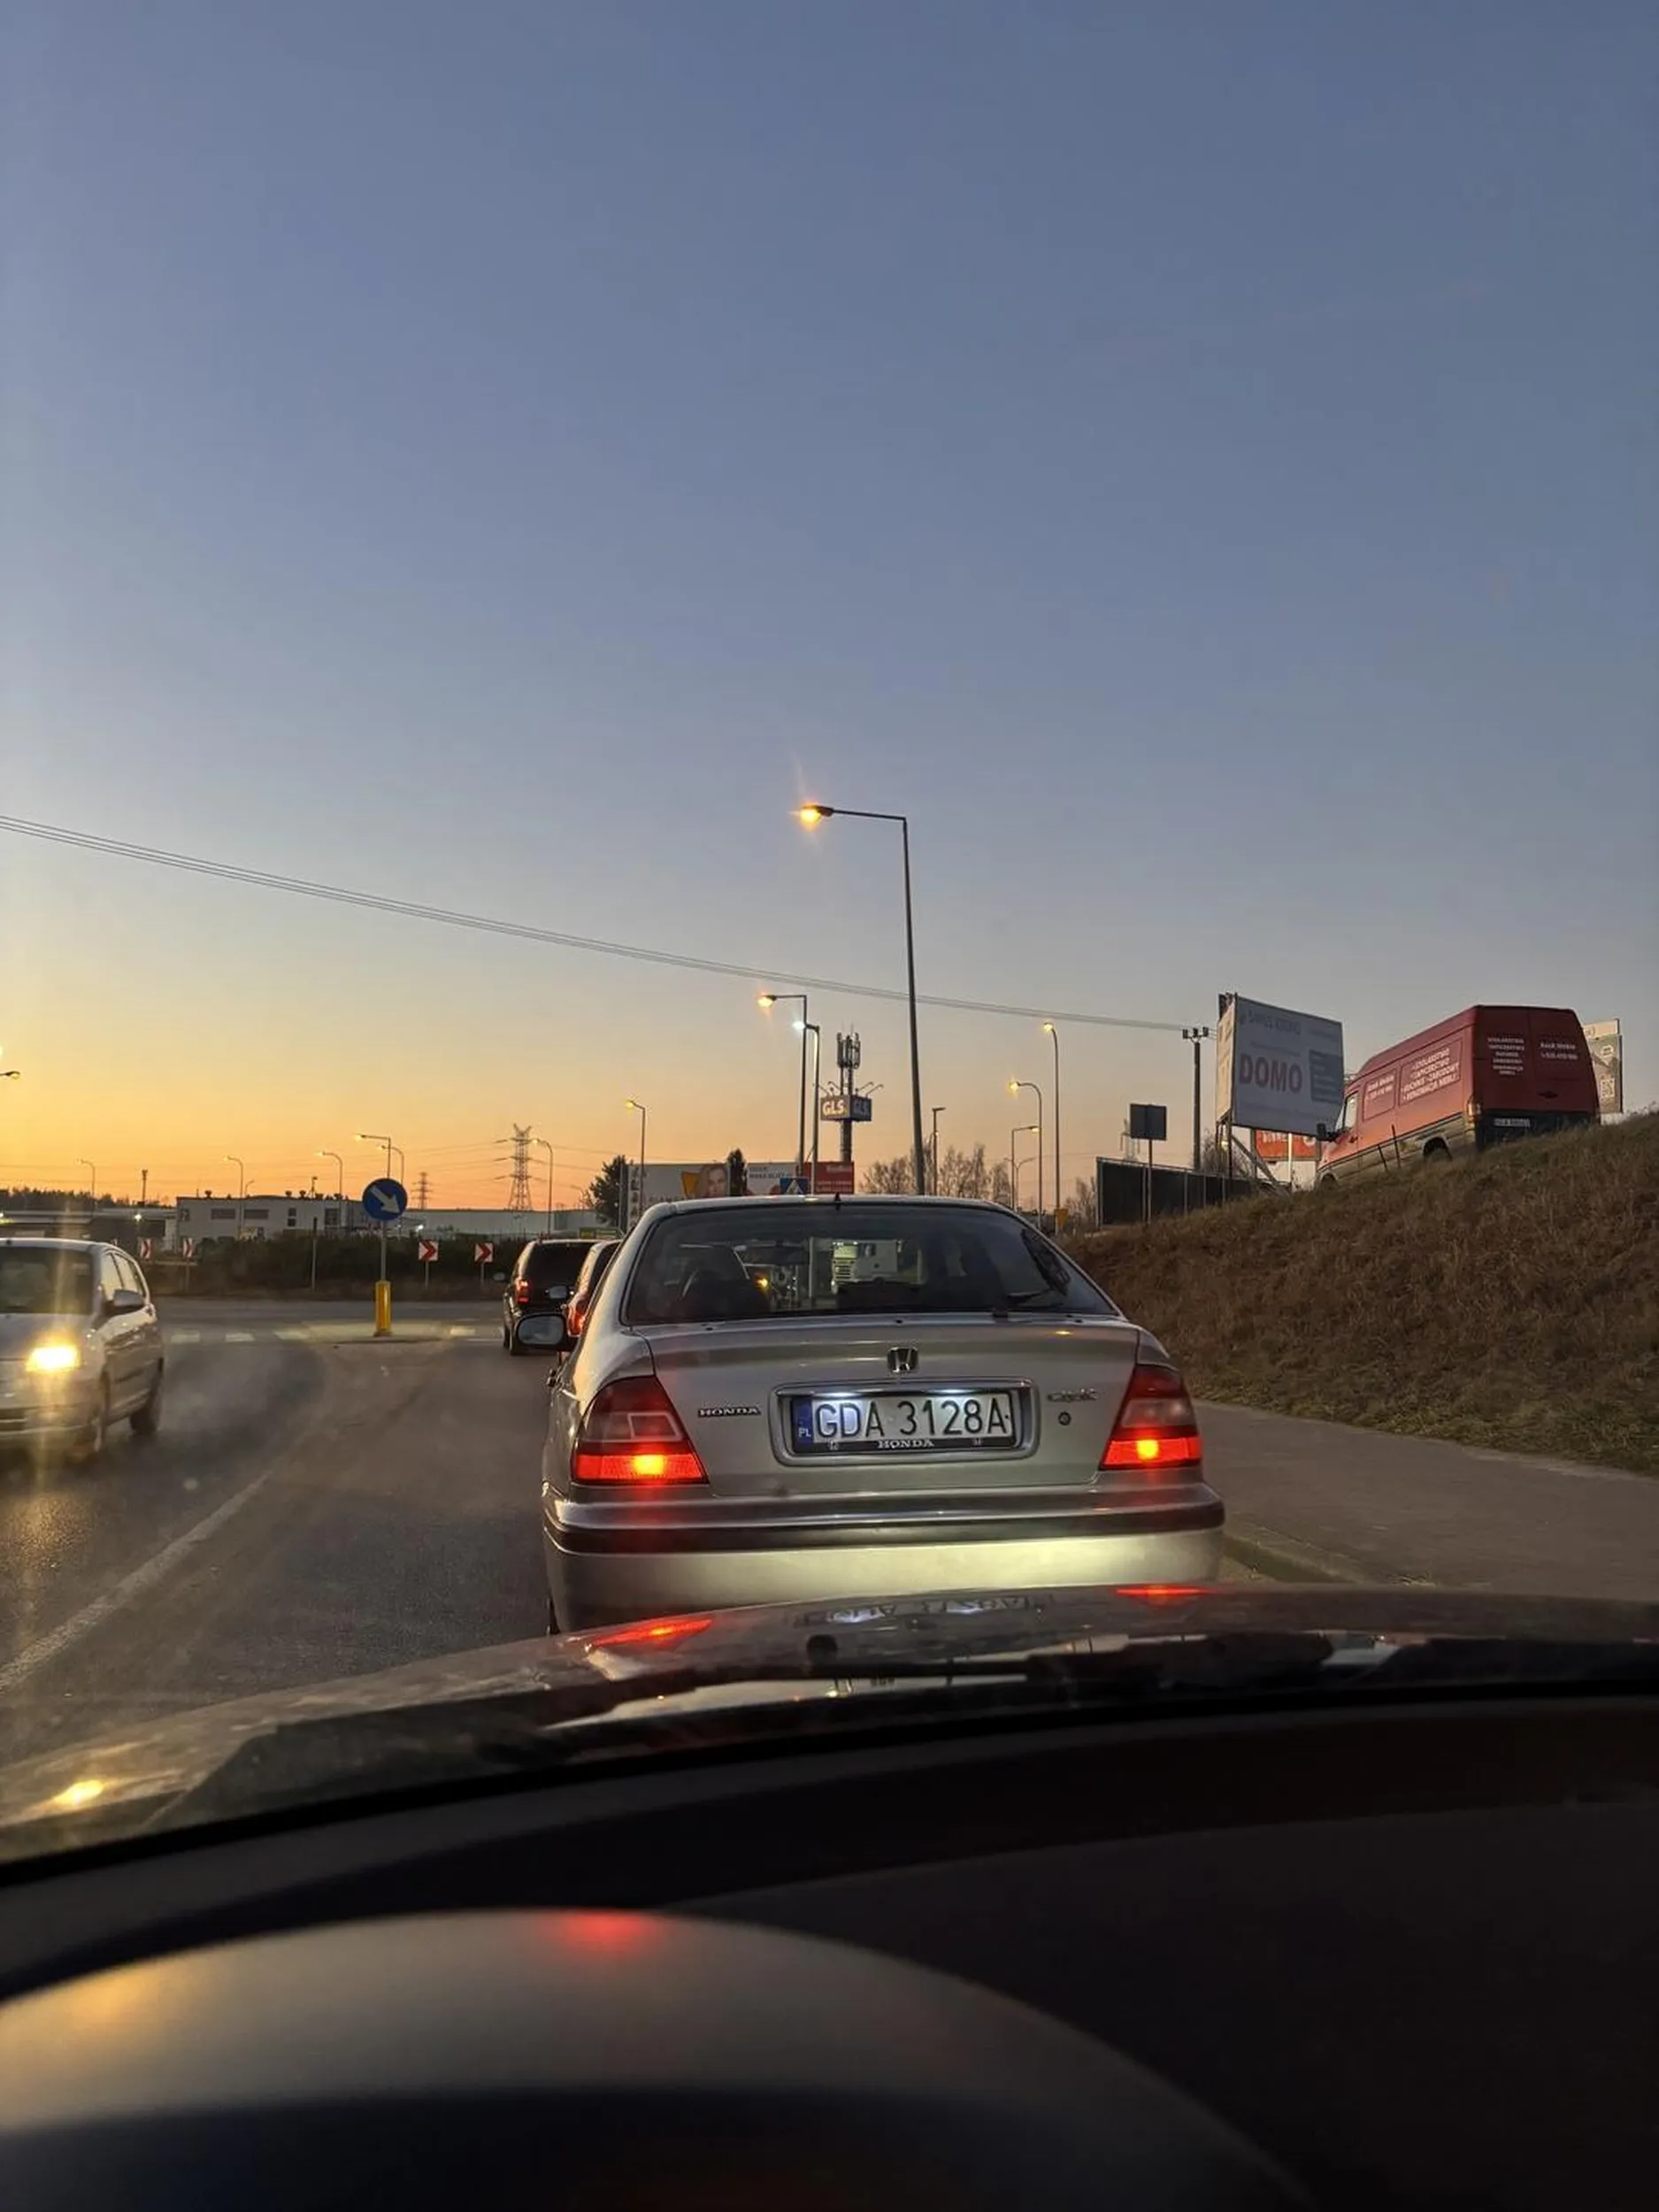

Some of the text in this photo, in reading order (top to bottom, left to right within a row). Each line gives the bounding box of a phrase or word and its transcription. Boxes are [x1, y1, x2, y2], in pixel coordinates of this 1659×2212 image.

[1239, 1052, 1303, 1094] DOMO
[822, 1098, 845, 1116] GLS
[698, 1407, 761, 1417] HONDA
[815, 1397, 1008, 1439] GDA 3128A
[798, 1427, 811, 1438] PL
[877, 1438, 935, 1449] HONDA
